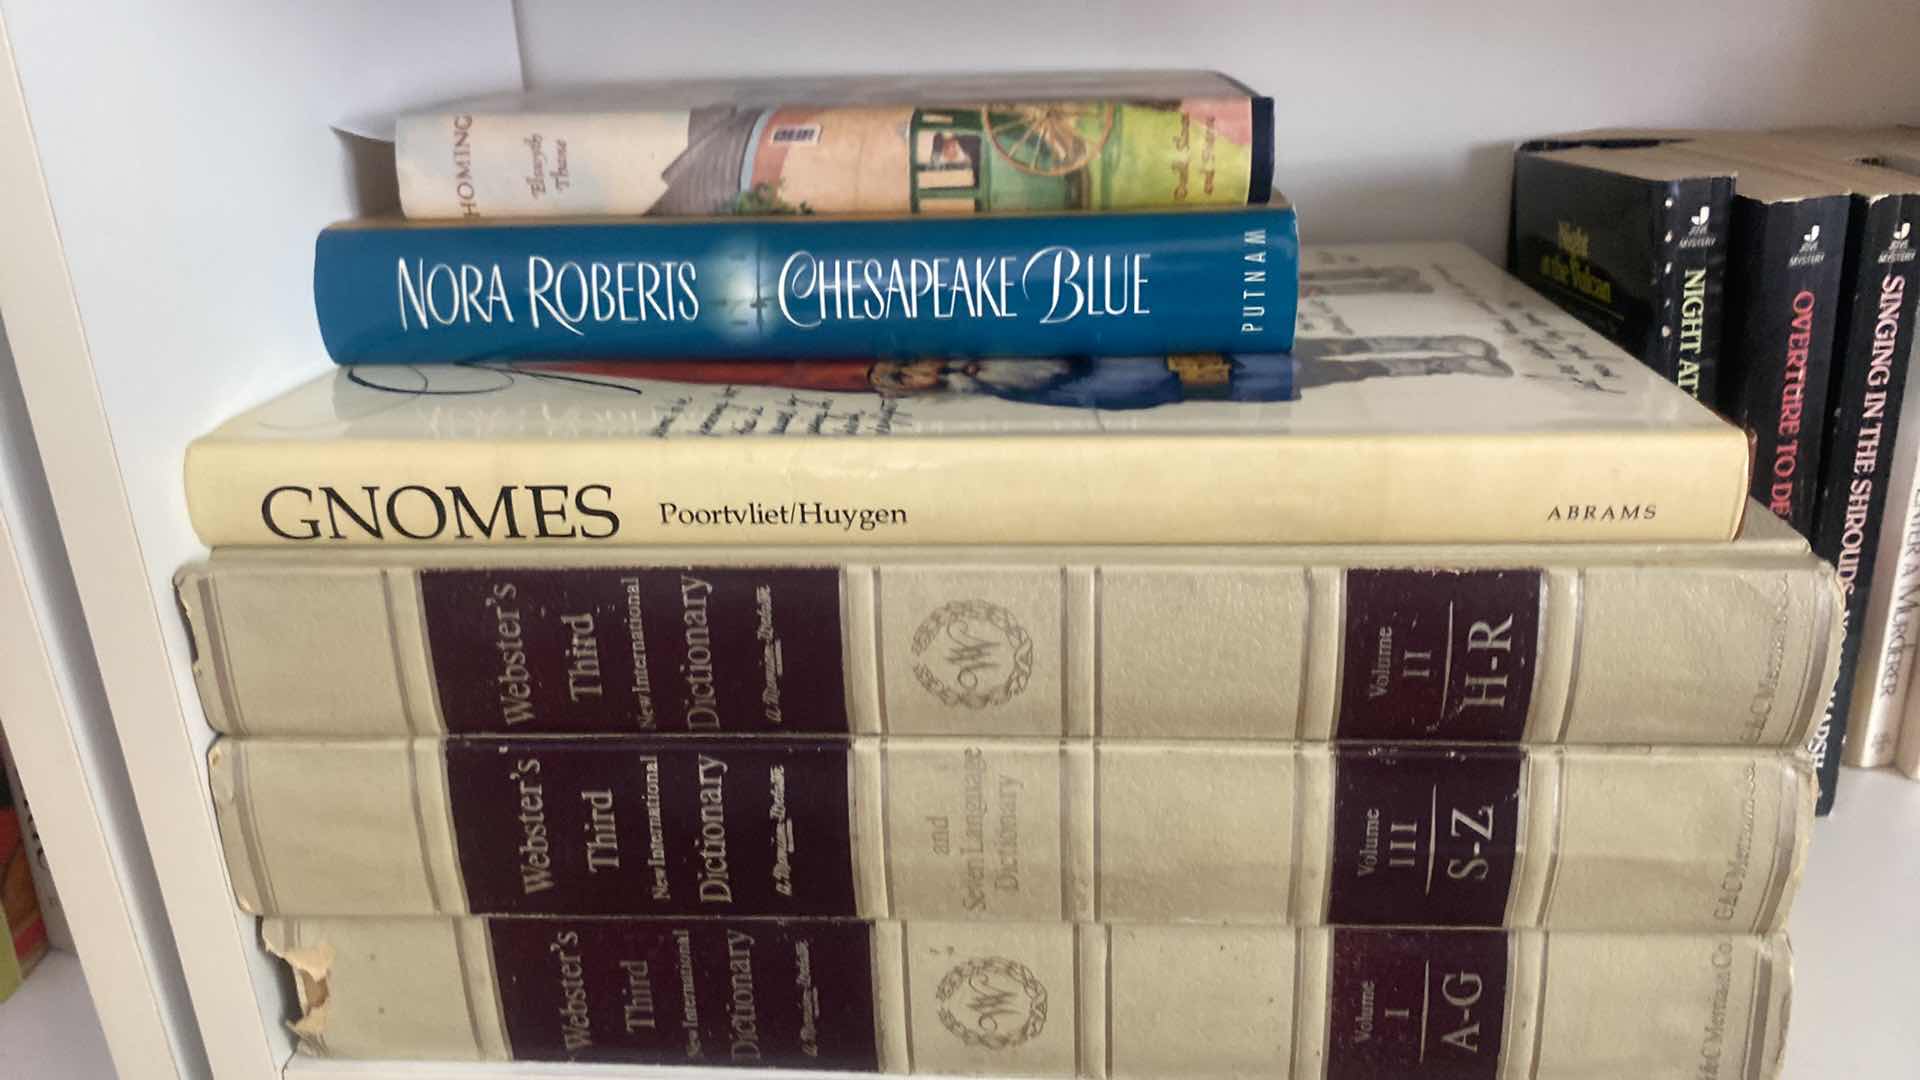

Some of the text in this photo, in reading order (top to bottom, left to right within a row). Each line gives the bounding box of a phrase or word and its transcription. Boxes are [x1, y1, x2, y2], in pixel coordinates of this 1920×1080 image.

[453, 112, 480, 220] HOMING
[1241, 229, 1267, 332] PUTNAM
[1679, 236, 1717, 249] MYSTERY
[1788, 253, 1826, 268] MYSTERY
[1877, 250, 1917, 265] MYSTERY
[397, 245, 1151, 336] NORA ROBERTS CHESAPEAKE BLUE
[1680, 267, 1707, 354] NIGHT
[1866, 273, 1906, 388] SINGING
[1778, 290, 1816, 436] OVERTURE
[1862, 391, 1888, 420] IN
[1774, 439, 1798, 477] TO
[1854, 422, 1882, 475] THE
[261, 485, 1657, 540] GNOMES Poortvliet/Huygen ABRAMS
[1838, 478, 1873, 595] SHROUDS
[485, 582, 537, 726] Webster's
[561, 612, 603, 703] Third
[620, 576, 651, 695] International
[680, 574, 721, 730] Dictionary
[1368, 625, 1393, 698] Volume
[1402, 649, 1432, 679] II
[1462, 614, 1513, 709] H-R
[510, 757, 557, 895] Webster's
[582, 787, 620, 873] Third
[640, 754, 671, 900] New International
[694, 753, 734, 904] Dictionary
[930, 815, 950, 857] and
[994, 772, 1024, 893] Dictionary
[1357, 807, 1381, 877] Volume
[1389, 820, 1418, 867] III
[1446, 804, 1494, 881] S-Z
[550, 930, 593, 1051] Webster's
[619, 959, 656, 1033] Third
[671, 928, 699, 1028] International
[726, 928, 761, 1061] Dictionary
[1353, 979, 1377, 1043] Volume
[1384, 1007, 1410, 1020] I
[1441, 970, 1484, 1053] A-G
